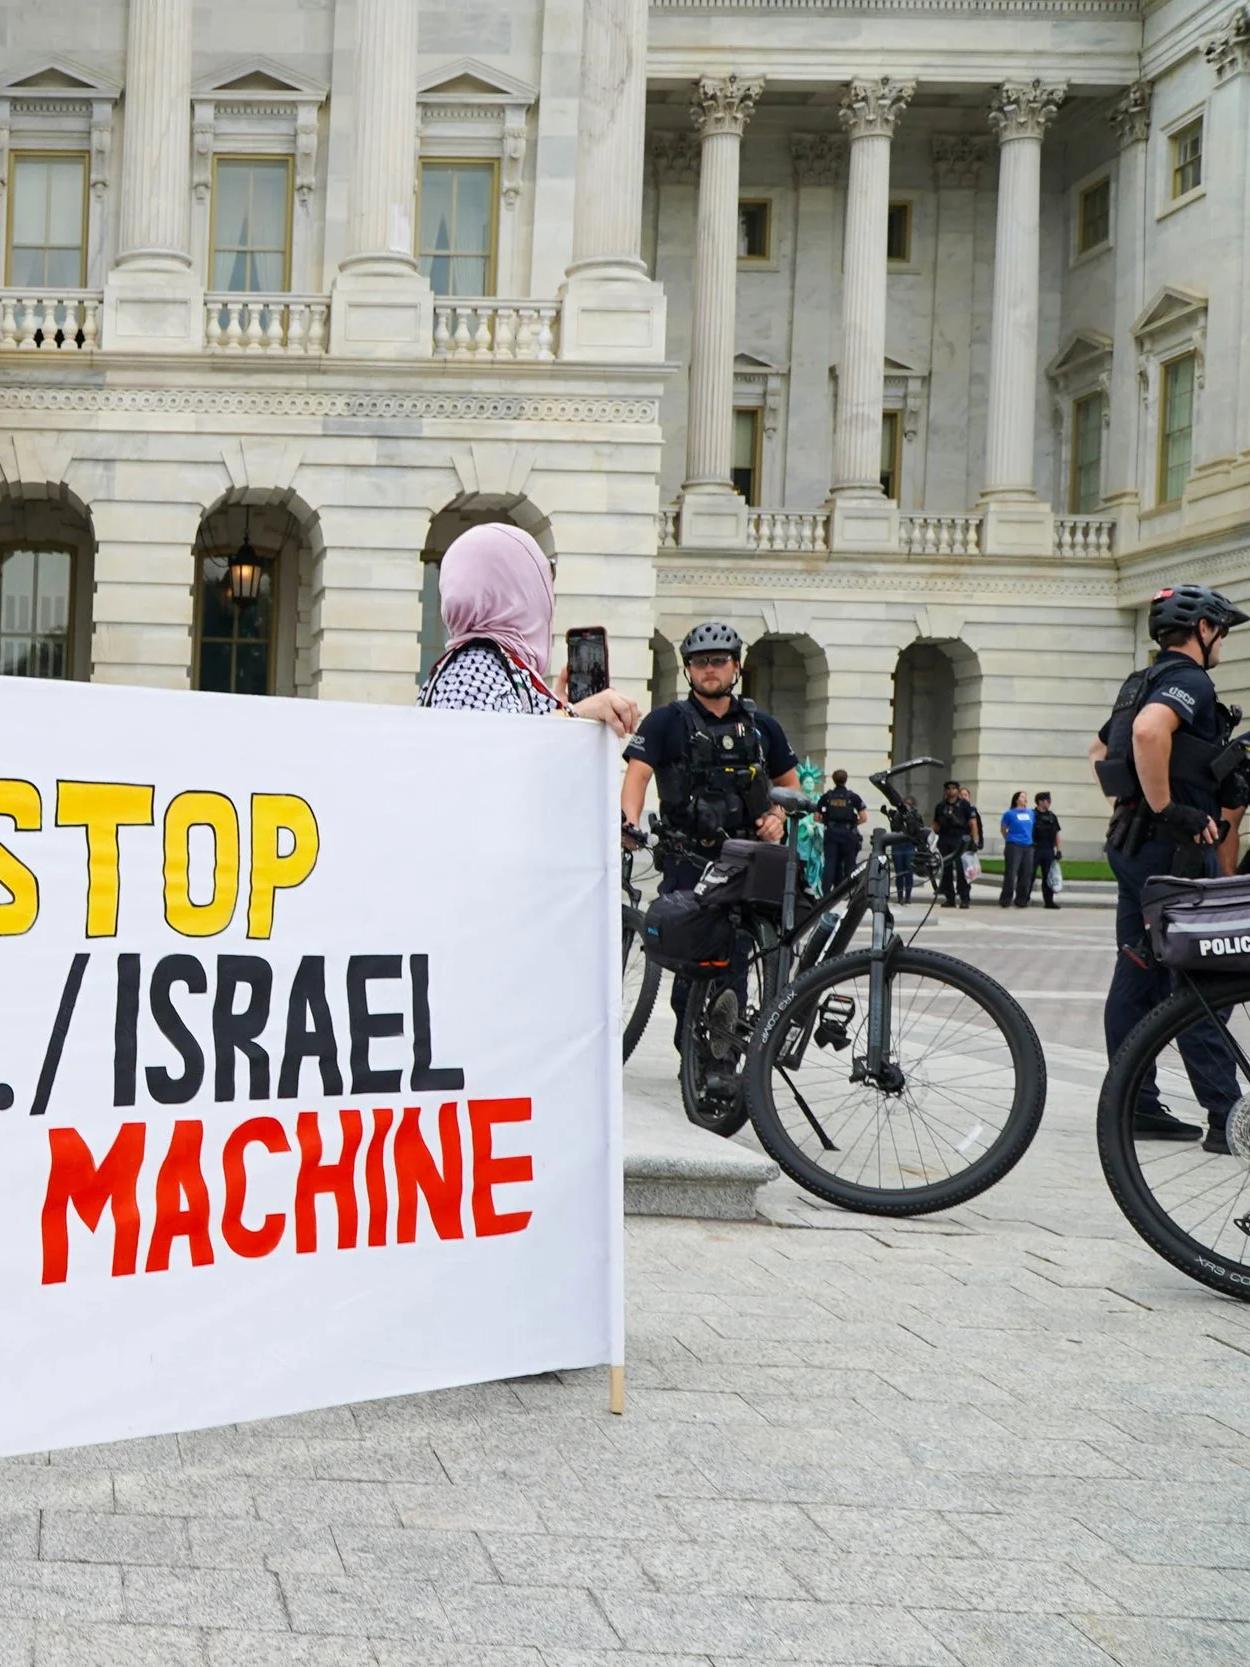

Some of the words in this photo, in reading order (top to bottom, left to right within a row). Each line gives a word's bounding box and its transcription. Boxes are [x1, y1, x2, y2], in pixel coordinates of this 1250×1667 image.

[1168, 686, 1196, 706] USCP
[761, 1010, 781, 1044] COMP
[41, 1098, 533, 1285] MACHINE
[1194, 1255, 1226, 1277] XR3
